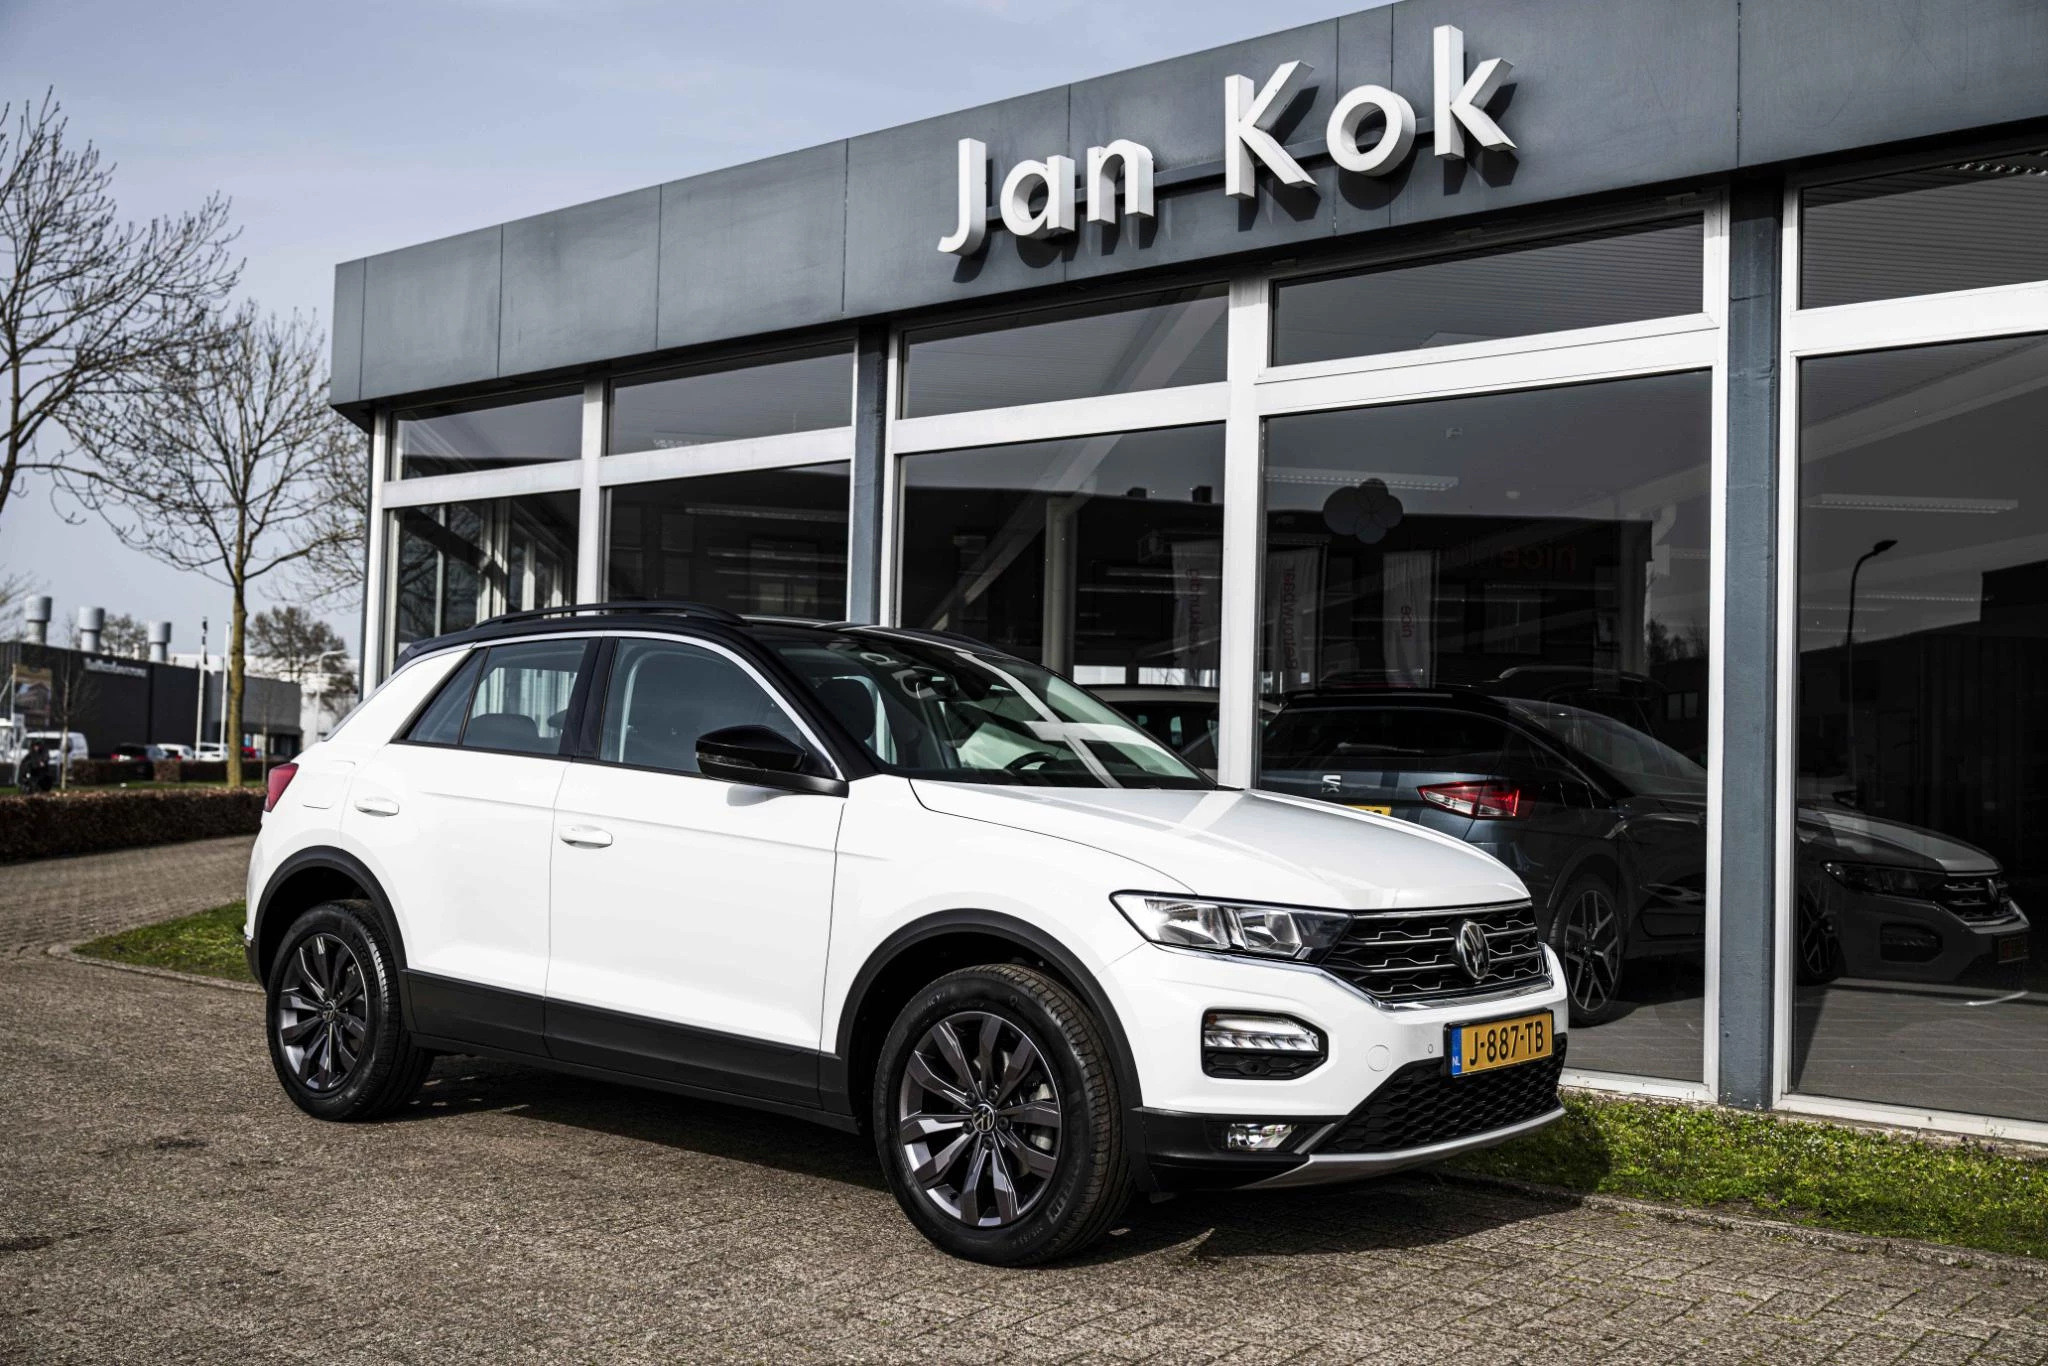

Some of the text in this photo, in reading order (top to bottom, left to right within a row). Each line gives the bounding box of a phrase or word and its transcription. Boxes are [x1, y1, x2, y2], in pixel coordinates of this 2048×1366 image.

[937, 24, 1518, 256] Jan Kok
[1452, 1055, 1461, 1067] NL
[1469, 1020, 1544, 1066] J-887-TB
